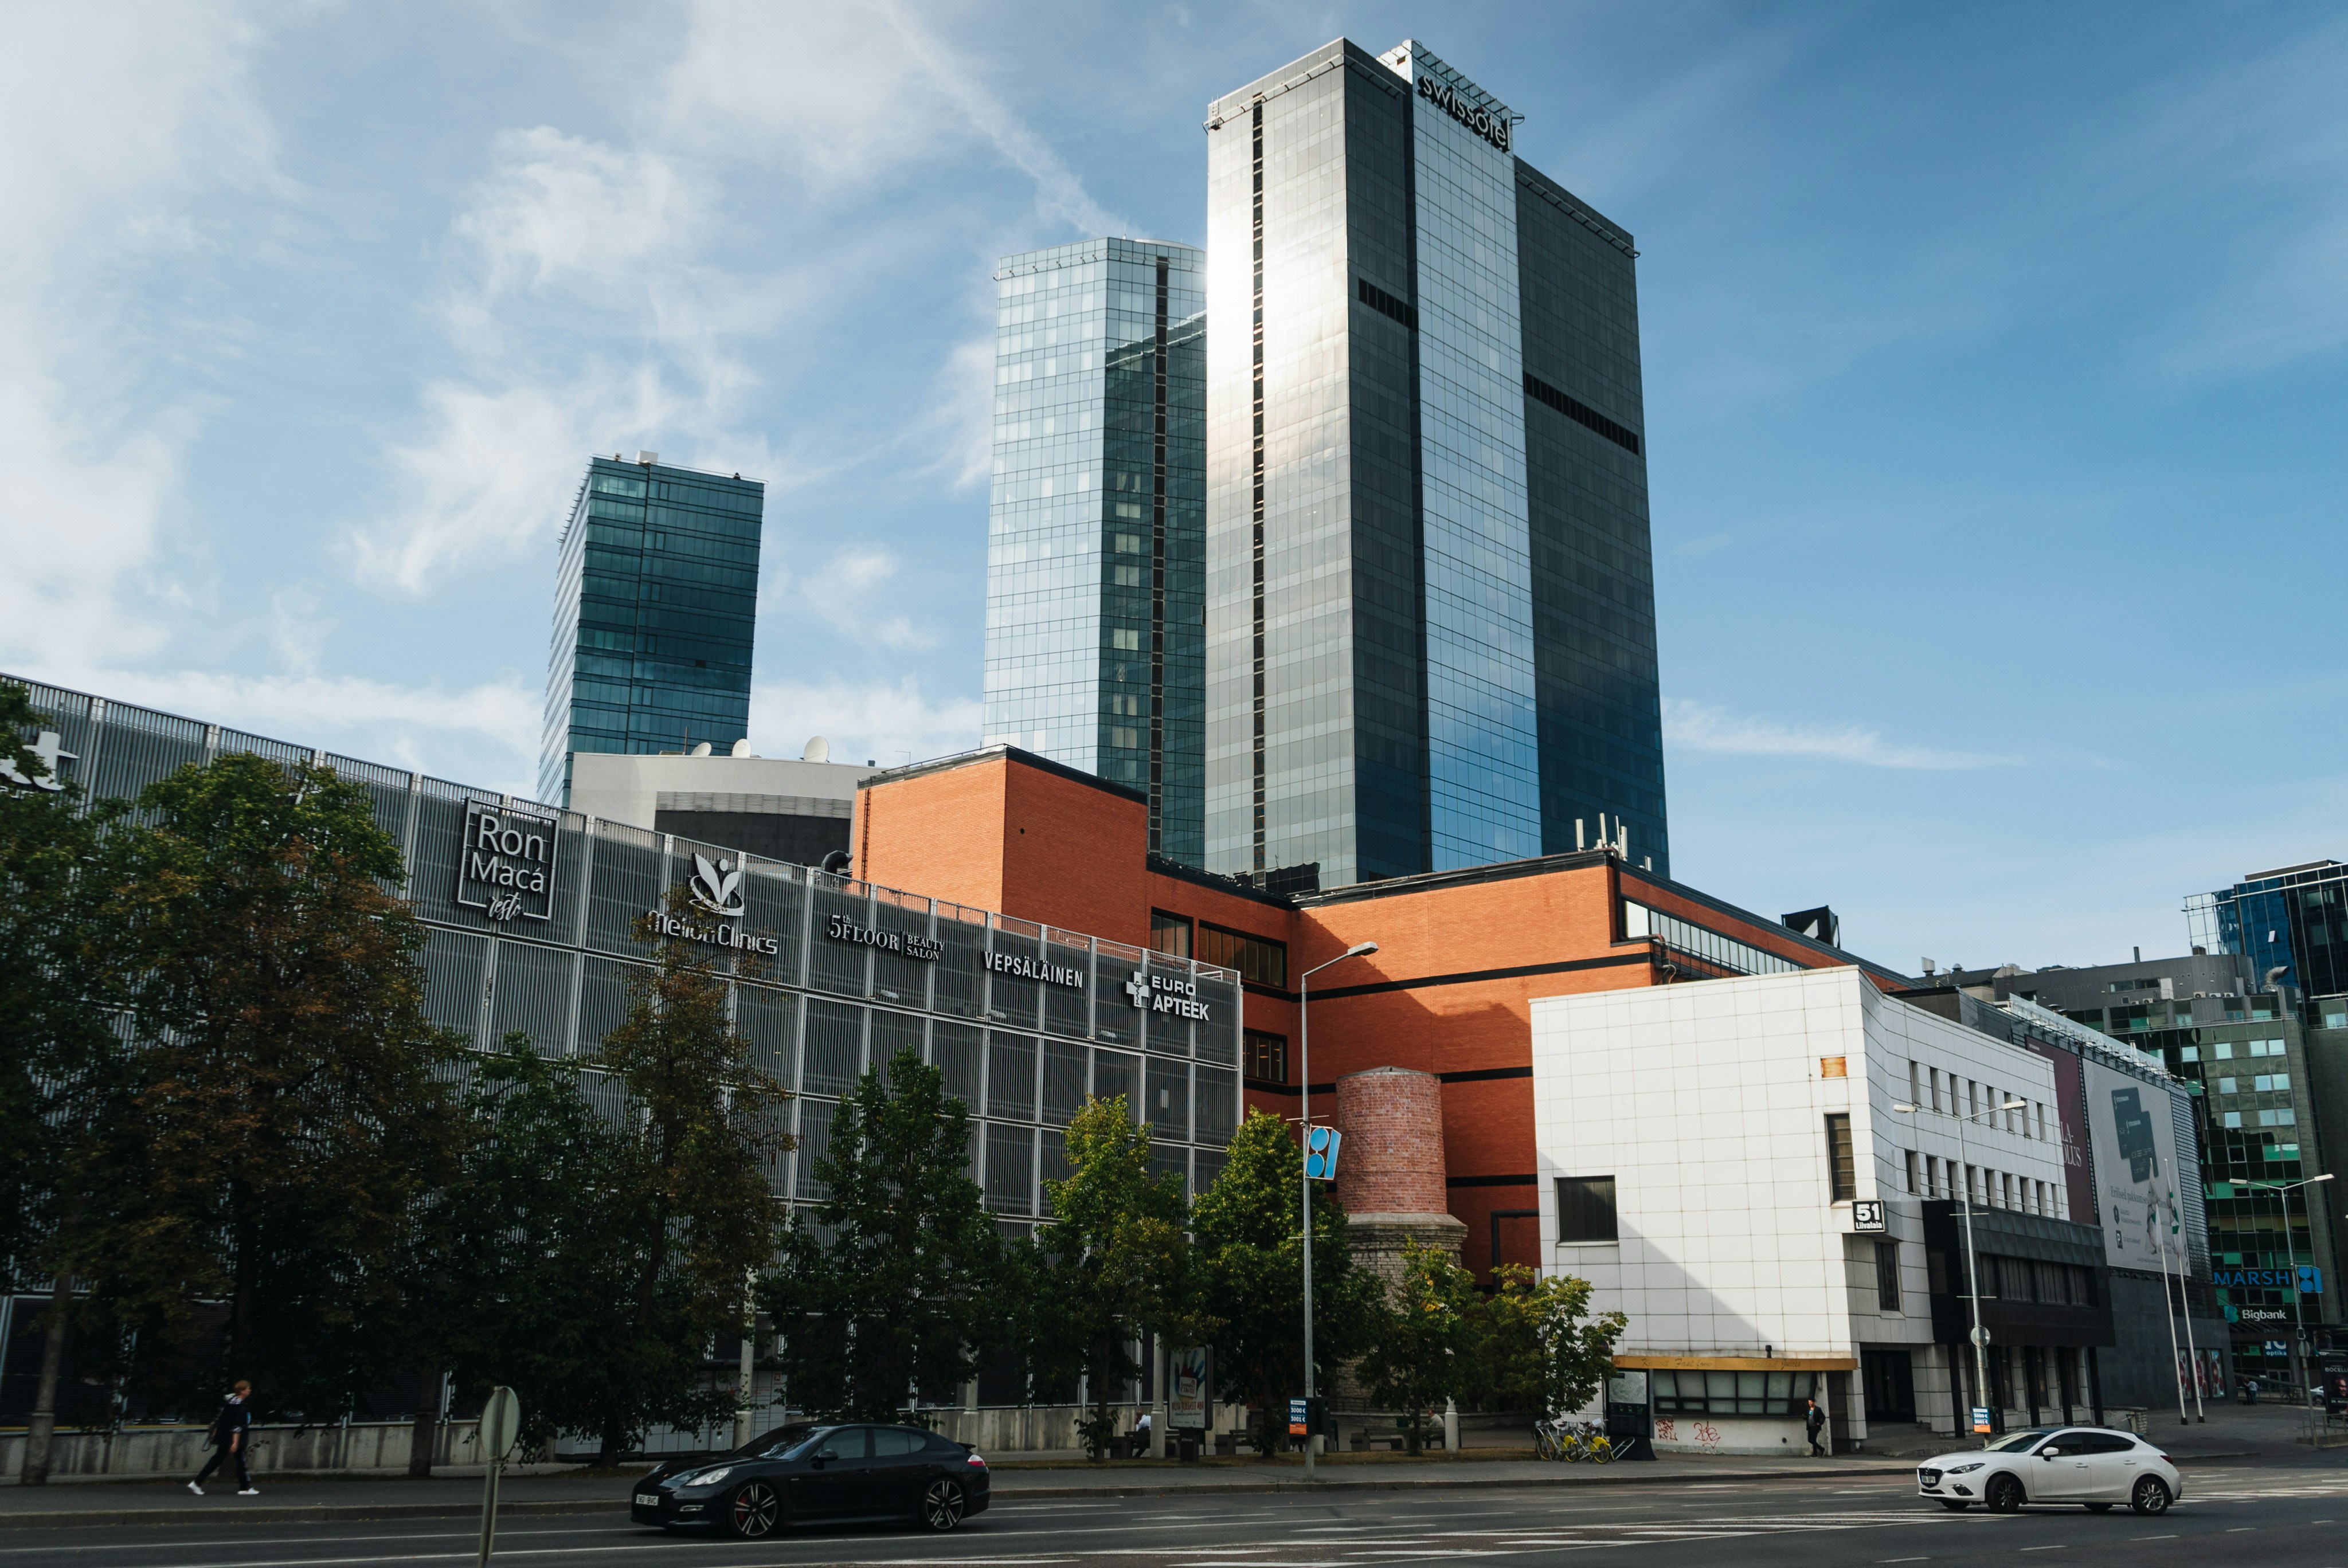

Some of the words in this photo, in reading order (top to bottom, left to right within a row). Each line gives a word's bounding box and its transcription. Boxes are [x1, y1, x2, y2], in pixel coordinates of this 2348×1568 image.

[478, 814, 543, 861] Ron
[470, 852, 545, 892] Macá
[842, 923, 899, 951] FLOOR
[907, 934, 945, 952] BEAUTY
[906, 946, 940, 961] SALON
[984, 951, 1083, 989] VEPSÄLÄINEN
[1151, 975, 1196, 997] EURO
[1152, 994, 1210, 1021] APTEEK
[1856, 1203, 1880, 1221] 51
[2213, 1271, 2290, 1285] MARSH
[2242, 1309, 2287, 1322] Bigbank
